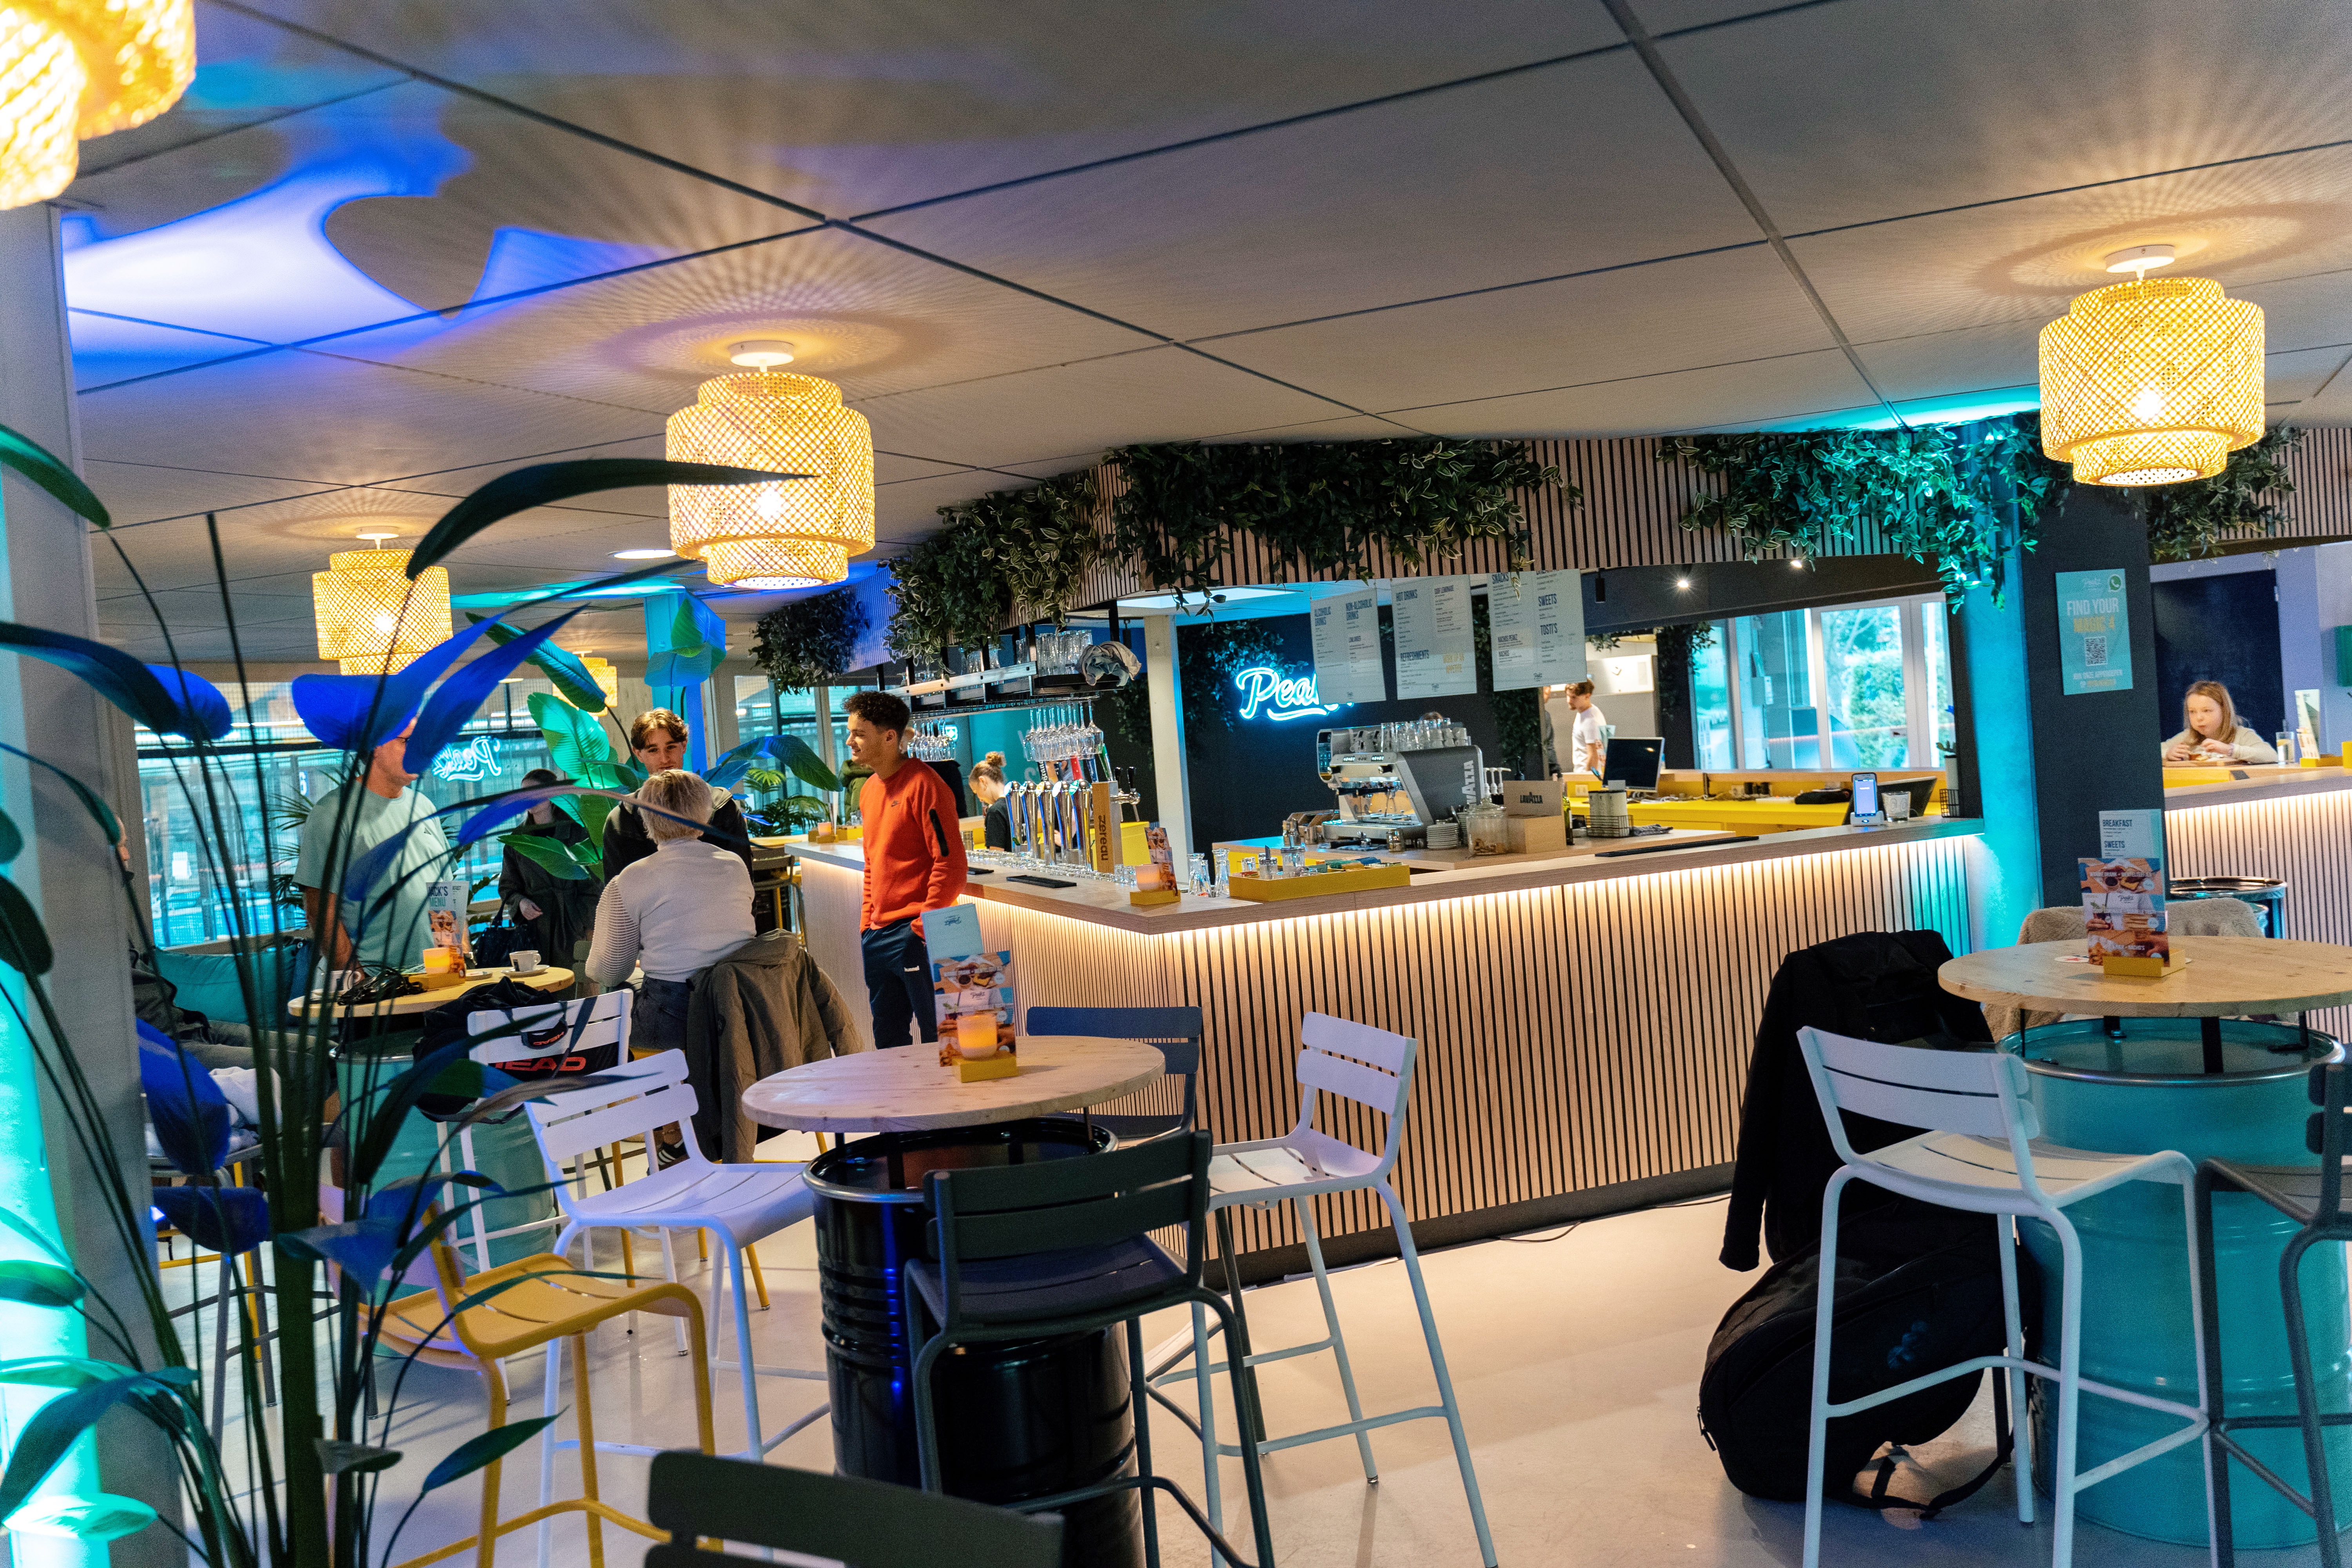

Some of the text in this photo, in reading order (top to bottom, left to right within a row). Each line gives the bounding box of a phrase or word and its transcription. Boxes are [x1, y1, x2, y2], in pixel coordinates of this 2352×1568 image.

[1396, 589, 1418, 602] HOT DRINKS
[1538, 593, 1557, 606] SWEETS
[2067, 597, 2120, 616] FIND YOUR
[1540, 623, 1558, 635] TOSTI'S
[1400, 650, 1429, 662] REFRESHMENTS
[1235, 666, 1329, 720] Pea
[1462, 760, 1477, 804] VAZZA
[1520, 791, 1543, 804] LAVAZZA
[1098, 815, 1109, 861] zereau
[428, 886, 448, 897] ACK'S
[430, 897, 446, 907] MENU
[533, 1031, 565, 1045] HEAD
